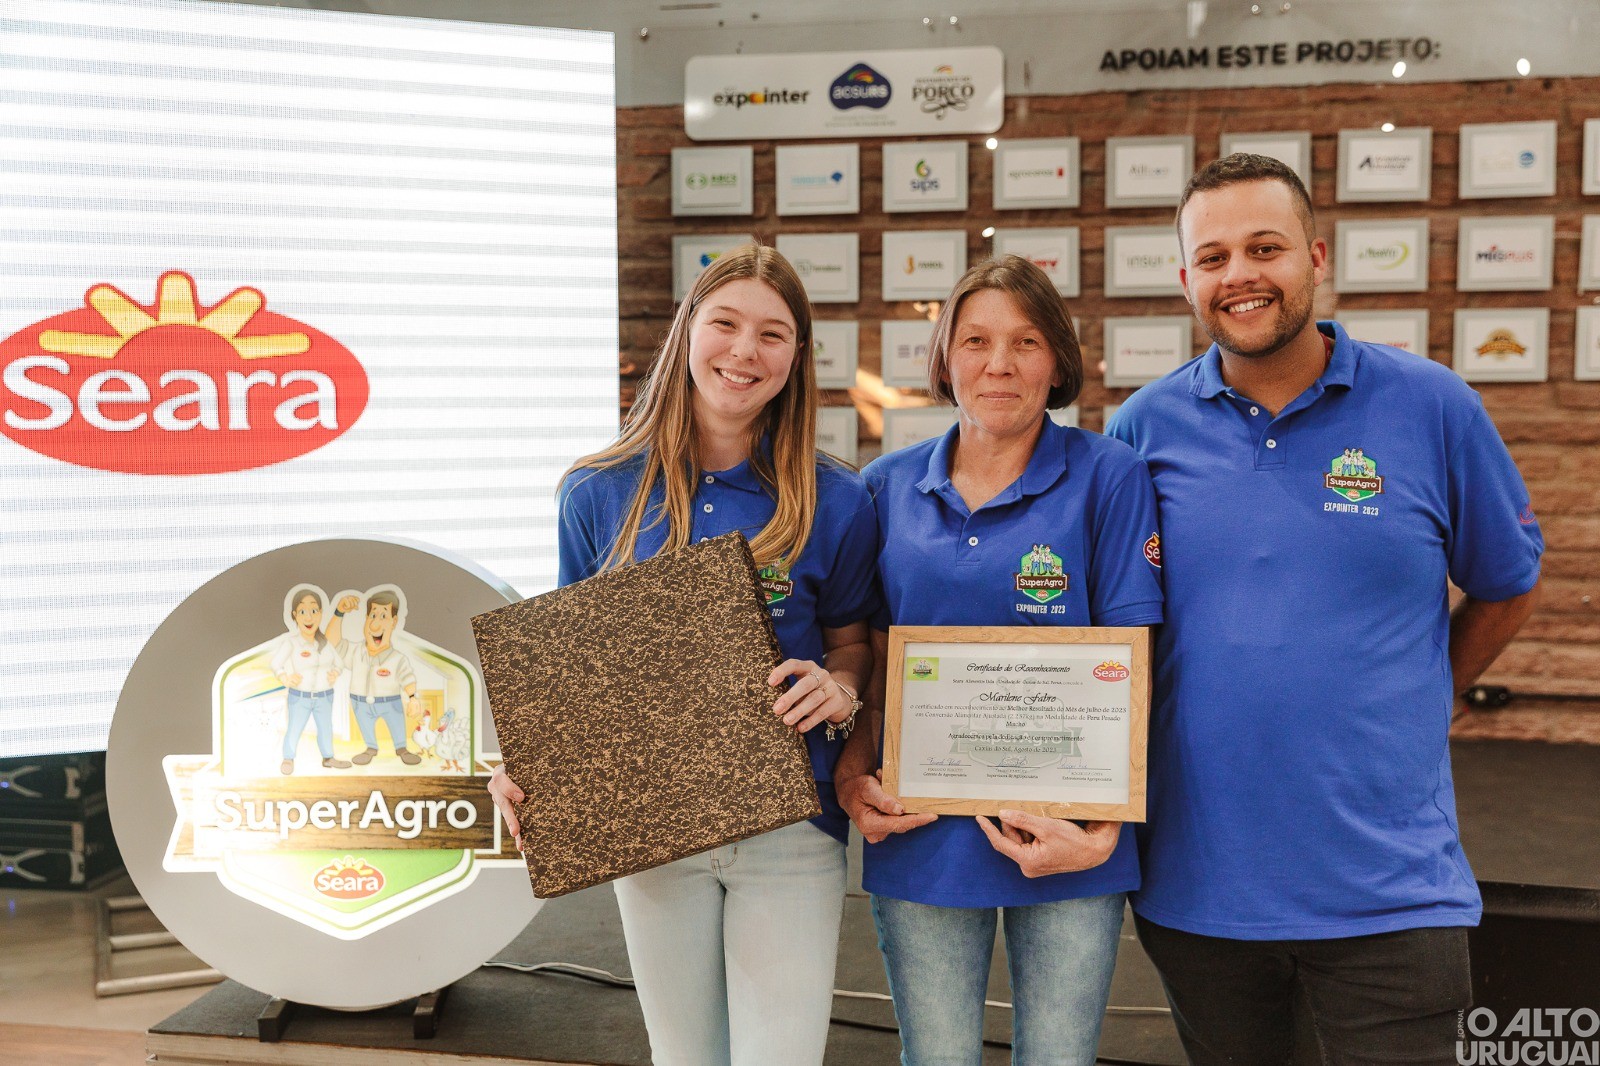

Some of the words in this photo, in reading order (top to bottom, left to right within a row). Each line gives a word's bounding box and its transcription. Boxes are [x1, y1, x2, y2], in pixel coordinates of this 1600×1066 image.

[1099, 48, 1209, 72] APOIAM
[1216, 43, 1287, 69] ESTE
[1295, 37, 1441, 64] PROJETO:
[912, 84, 974, 101] PORCO
[3, 355, 339, 431] Seara
[1329, 478, 1377, 488] SuperAgro
[1324, 502, 1359, 514] EXPOINTER
[1362, 505, 1379, 516] 2023
[761, 582, 789, 592] erAgro
[1020, 578, 1063, 588] SuperAgro
[1016, 603, 1047, 614] EXPOINTER
[1050, 605, 1066, 614] 2023
[966, 662, 1004, 674] Certificado
[1004, 664, 1013, 672] de
[1094, 668, 1127, 678] Seara
[979, 692, 1022, 702] Marilene
[1023, 692, 1057, 706] Fabro
[214, 790, 478, 840] SuperAgro
[317, 873, 380, 892] Seara
